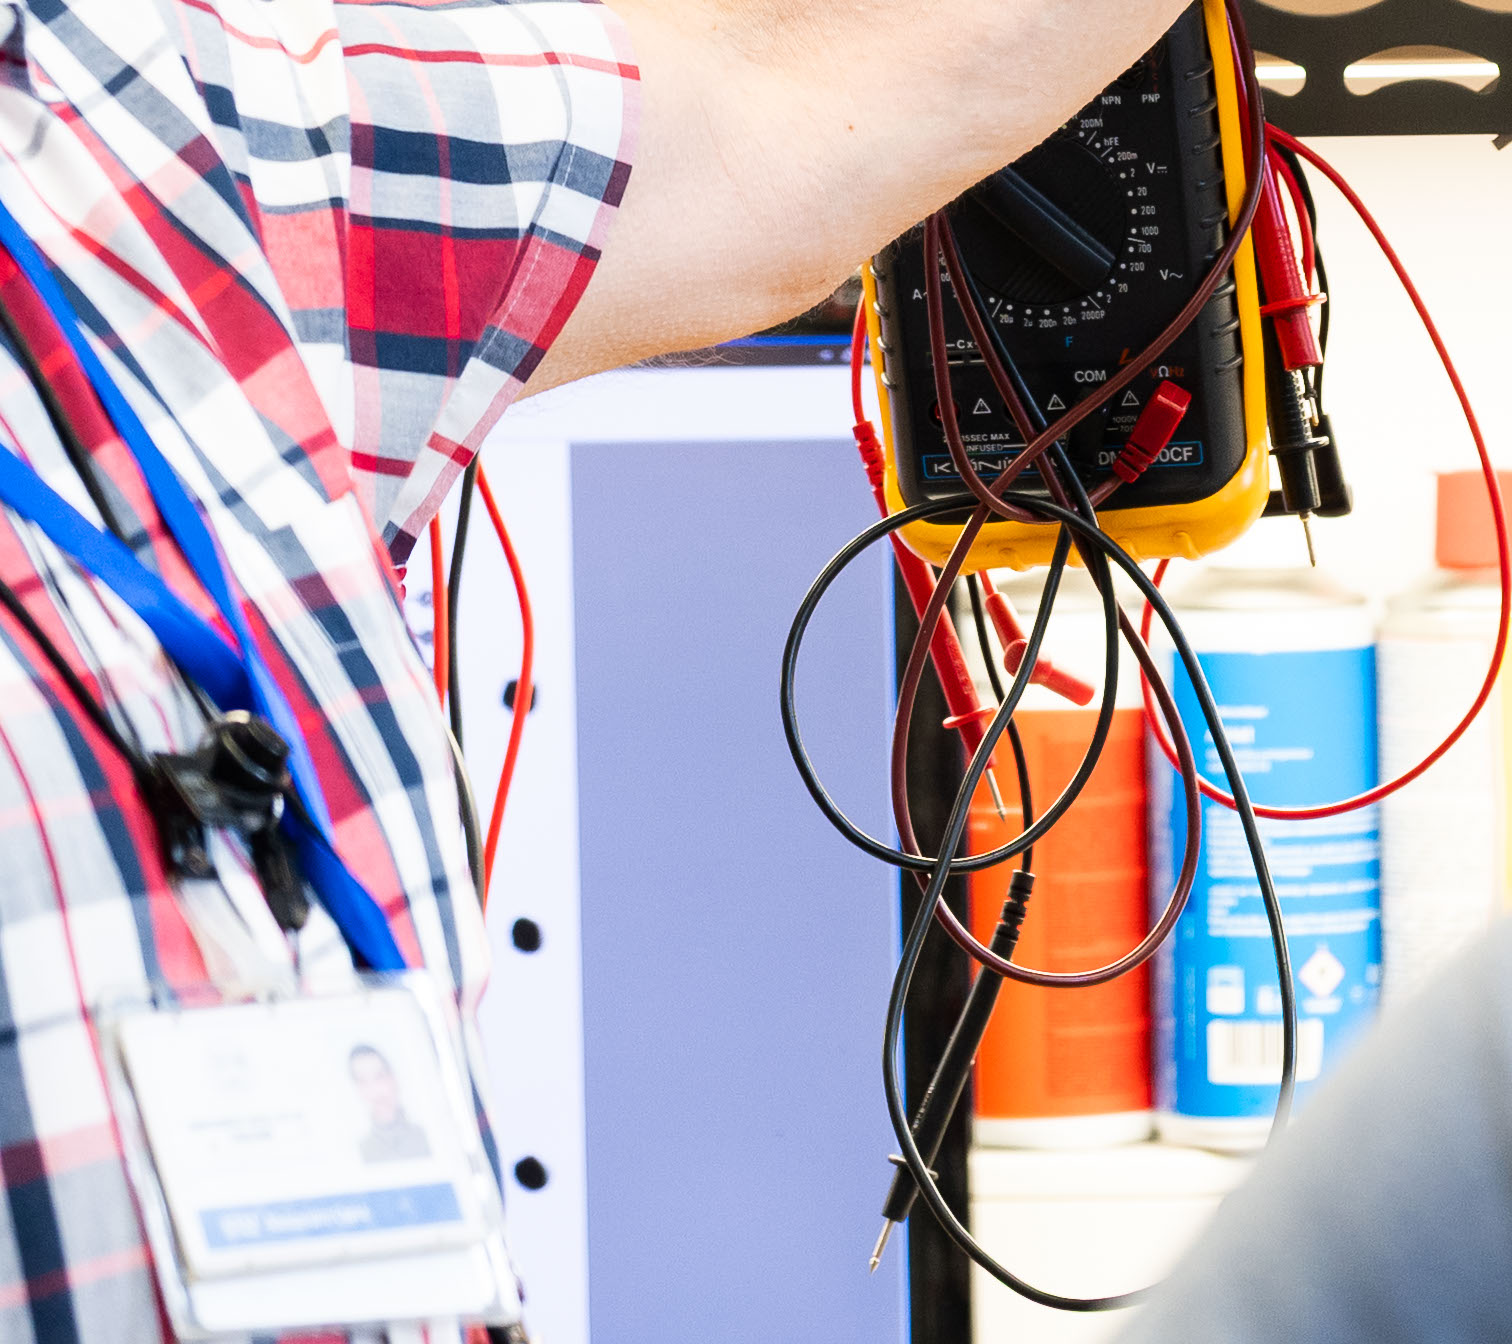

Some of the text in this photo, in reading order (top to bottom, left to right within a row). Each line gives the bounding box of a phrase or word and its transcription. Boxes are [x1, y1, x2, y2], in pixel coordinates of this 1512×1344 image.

[1101, 93, 1161, 105] NPN PNP
[1080, 118, 1103, 128] 200M
[1104, 137, 1120, 147] hFE
[1117, 152, 1138, 161] 200m
[1137, 187, 1148, 197] 20
[1140, 205, 1156, 215] 200
[1141, 226, 1159, 235] 1000
[1138, 243, 1152, 253] 700
[1129, 262, 1145, 272] 200
[1118, 283, 1128, 293] 20
[1065, 335, 1073, 348] F
[1074, 369, 1107, 383] COM
[990, 432, 1010, 441] MAX
